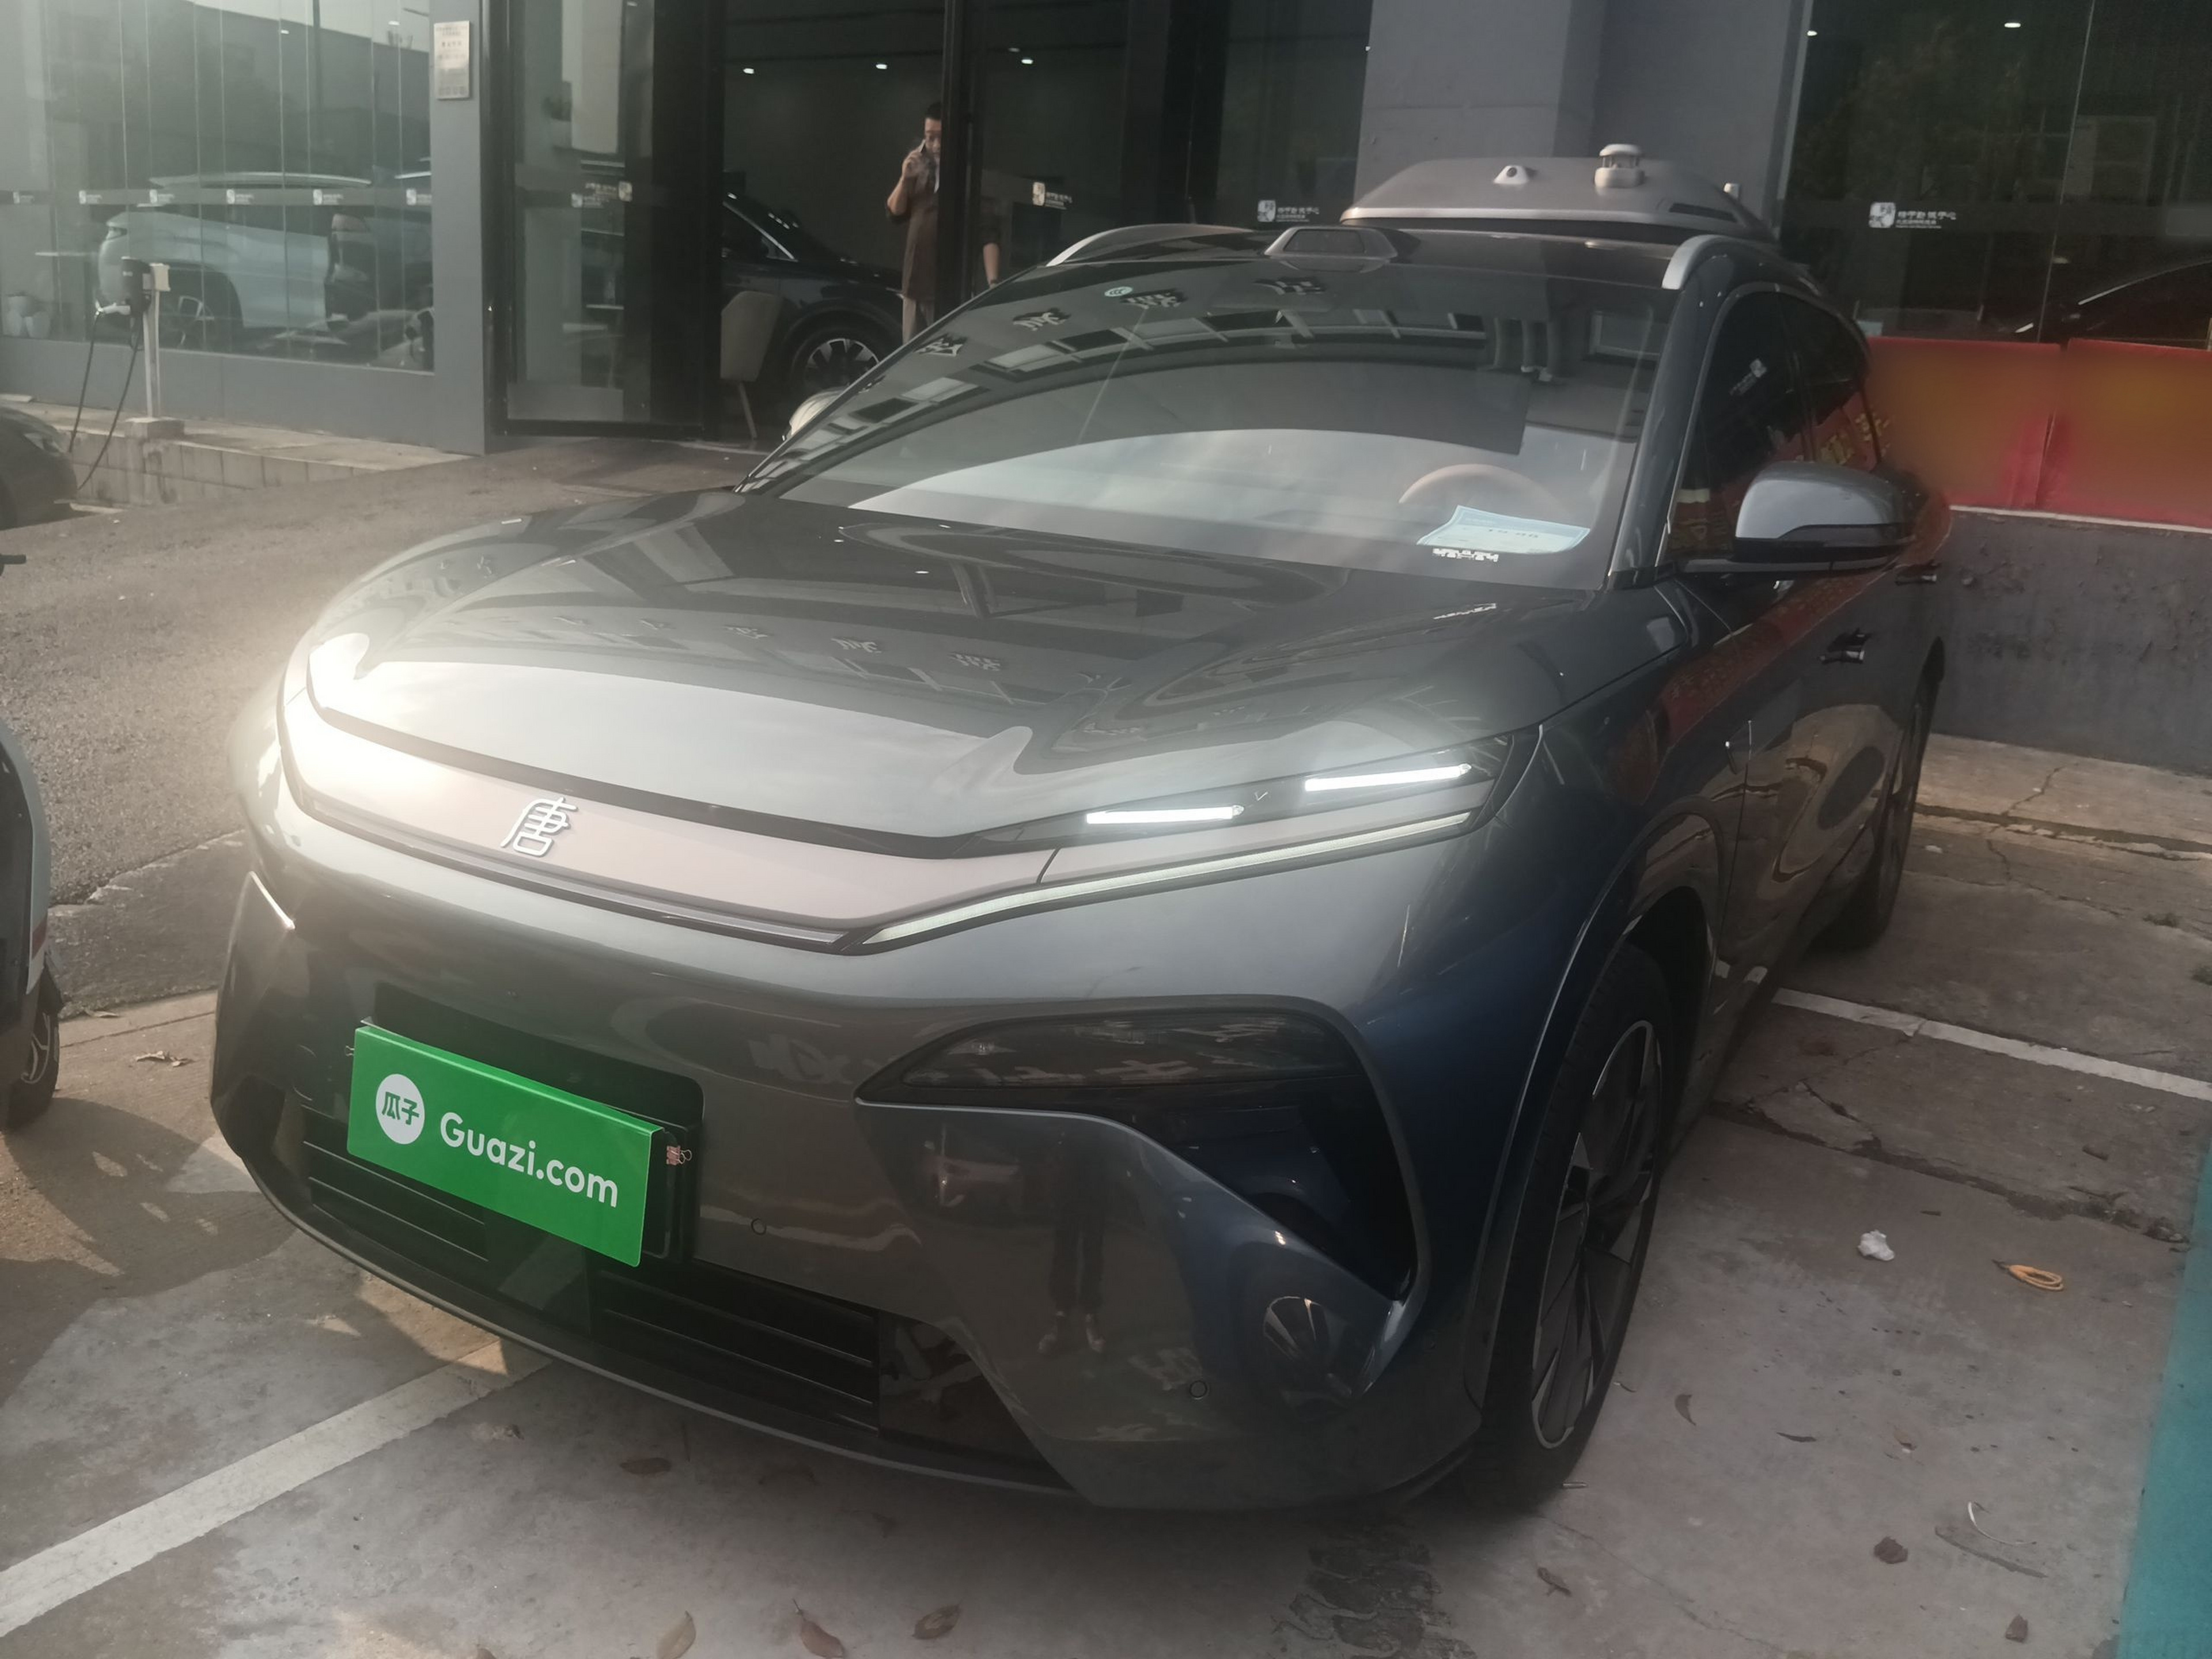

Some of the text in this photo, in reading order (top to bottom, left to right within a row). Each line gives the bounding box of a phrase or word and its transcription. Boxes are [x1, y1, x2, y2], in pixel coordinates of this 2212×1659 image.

[501, 797, 577, 856] 唐
[382, 1092, 618, 1208] 瓜子 Guazi.com
